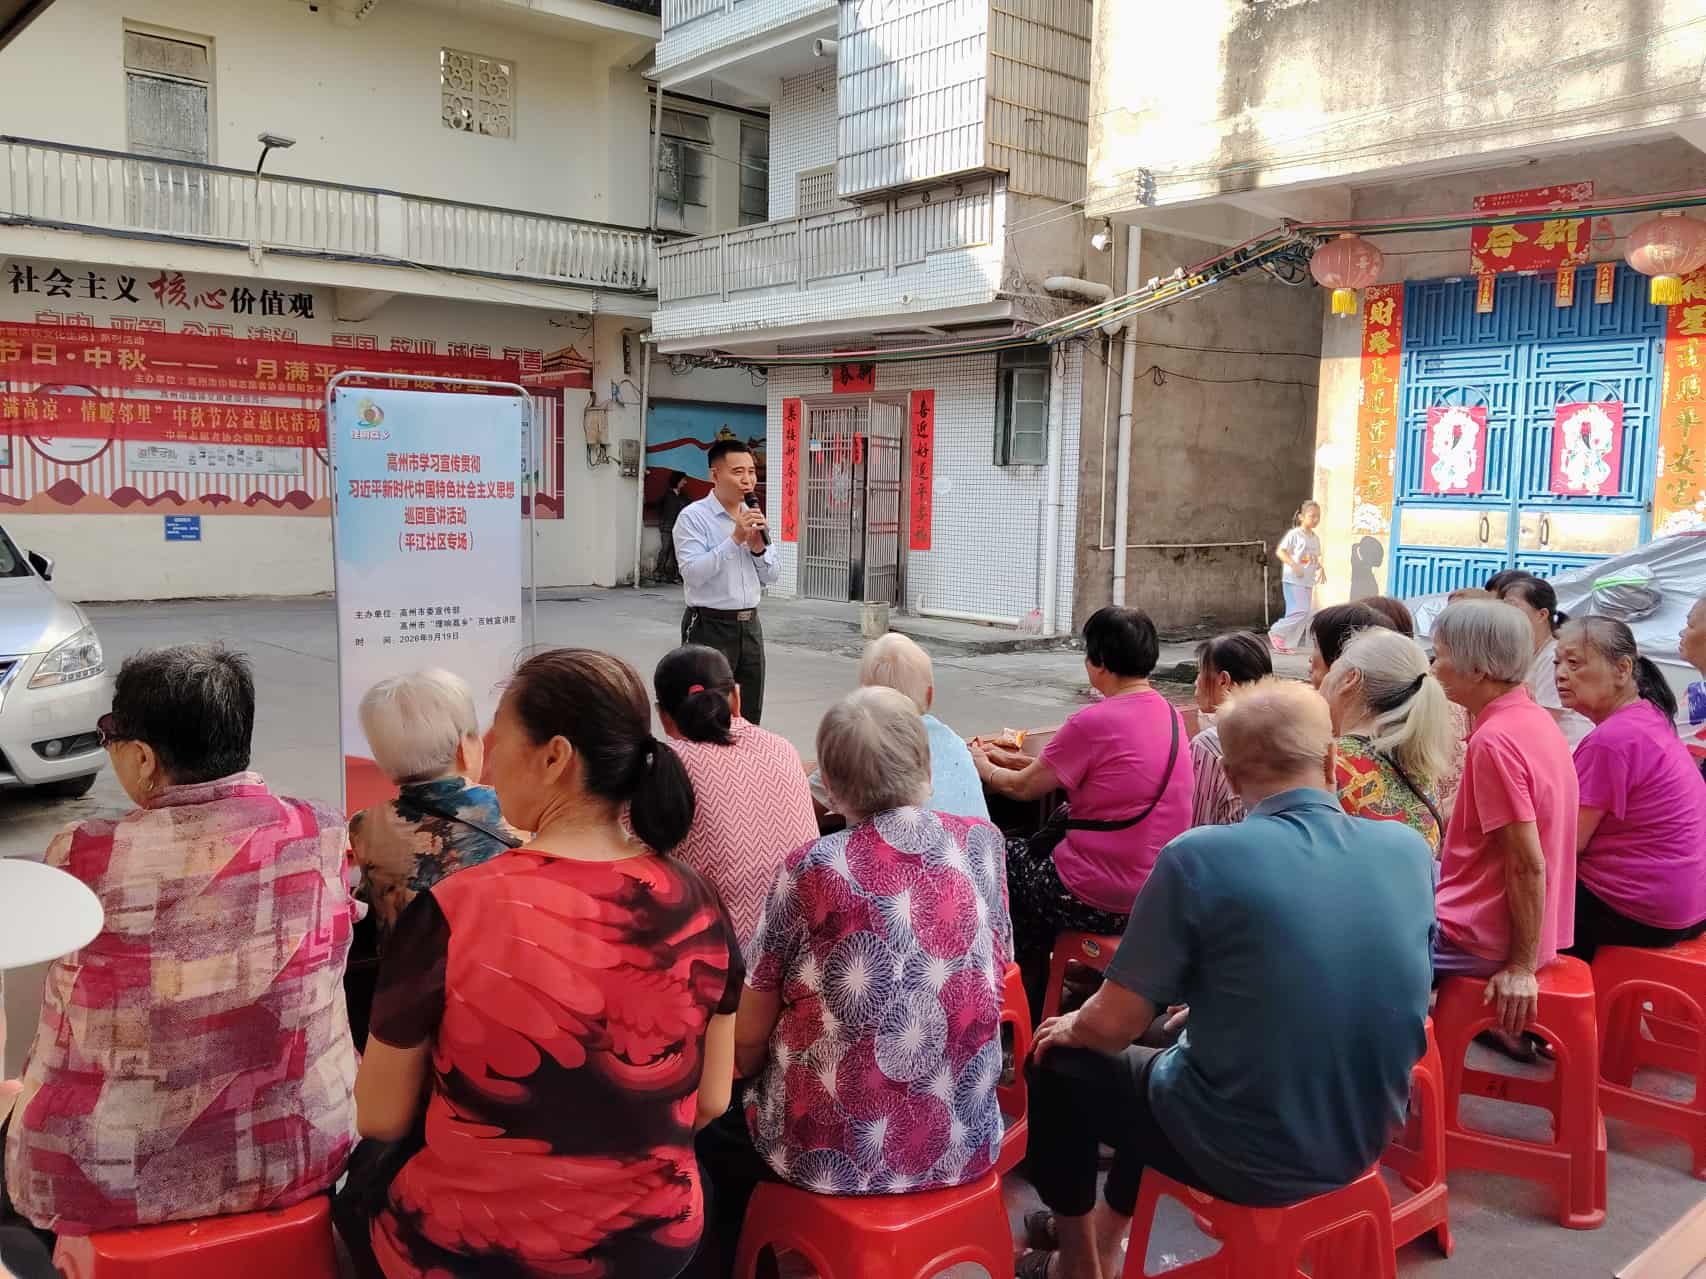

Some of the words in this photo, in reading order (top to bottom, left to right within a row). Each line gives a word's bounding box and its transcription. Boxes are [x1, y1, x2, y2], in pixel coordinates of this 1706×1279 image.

[8, 263, 316, 320] 社会主义核心价值观
[387, 453, 481, 473] 高州市学习宣传贯彻
[349, 480, 515, 499] 习近平新时代中国特色社会主义思想
[405, 506, 467, 525] 巡回宣讲活动
[398, 532, 474, 552] （平江社区专场）
